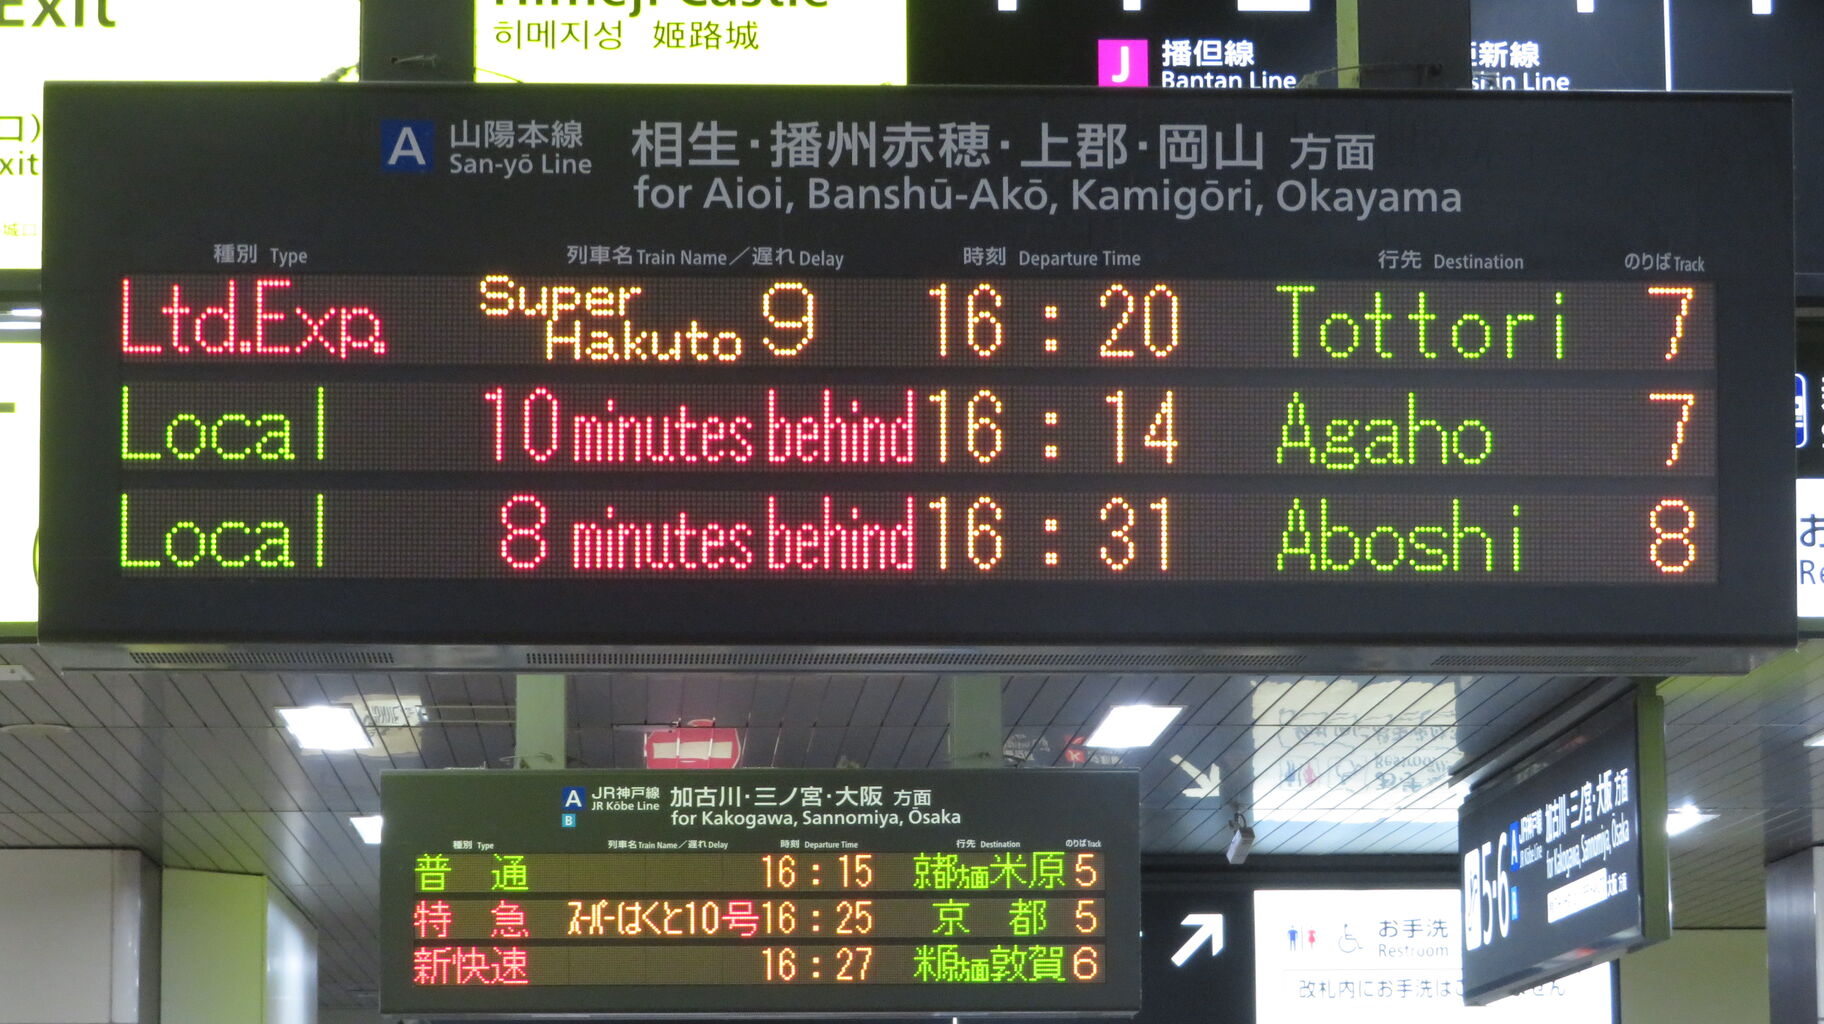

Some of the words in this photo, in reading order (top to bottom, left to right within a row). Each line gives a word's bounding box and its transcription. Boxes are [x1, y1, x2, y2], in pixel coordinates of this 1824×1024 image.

[493, 19, 623, 51] 히메지성
[1112, 45, 1130, 83] J
[1161, 39, 1256, 67] 播但線
[1470, 41, 1541, 69] 新線
[1161, 70, 1243, 88] Bantan
[1249, 70, 1298, 88] Line
[1522, 72, 1570, 91] Line
[387, 126, 427, 166] A
[449, 119, 584, 149] 山陽本線
[1290, 132, 1376, 172] 方面
[449, 152, 534, 180] San-yō
[541, 154, 593, 175] Line
[632, 174, 693, 210] for
[702, 177, 796, 214] Aioi,
[807, 177, 1059, 215] Banshū-Akō,
[1072, 178, 1264, 221] Kamigōri,
[1275, 178, 1463, 222] Okayama
[213, 243, 258, 265] 種別
[269, 246, 309, 267] Type
[566, 245, 633, 266] 列車名
[636, 249, 676, 266] Train
[799, 250, 844, 272] Delay
[963, 246, 1007, 267] 時刻
[1018, 250, 1098, 270] Departure
[1102, 250, 1142, 267] Time
[1377, 250, 1422, 270] 行先
[1433, 252, 1525, 270] Destination
[1623, 252, 1672, 272] のりば
[1674, 256, 1706, 274] Track
[480, 275, 642, 321] Super
[762, 282, 815, 357] 9
[1275, 284, 1565, 360] Tottori
[1648, 286, 1695, 361] 7
[546, 320, 743, 361] Hakuto
[121, 385, 326, 461] Local
[484, 387, 560, 463] 10
[572, 398, 754, 463] minutes
[767, 388, 916, 464] behind
[1276, 391, 1494, 471] Agaho
[1649, 392, 1696, 467] 7
[120, 492, 326, 569] Local
[500, 494, 548, 570] 8
[572, 505, 754, 570] minutes
[767, 495, 916, 571] behind
[1276, 497, 1521, 573] Aboshi
[1649, 498, 1696, 574] 8
[1799, 558, 1824, 586] R
[565, 789, 583, 808] A
[591, 801, 604, 812] JR
[606, 800, 635, 812] Kōbe
[637, 801, 661, 812] Line
[592, 786, 661, 801] JR神戸線
[893, 789, 932, 807] 方面
[564, 815, 574, 827] B
[671, 809, 698, 826] for
[702, 811, 799, 830] Kakogawa,
[802, 810, 905, 829] Sannomiya,
[908, 806, 962, 825] Ōsaka
[452, 839, 474, 850] 種別
[477, 841, 495, 850] Type
[607, 839, 638, 850] 列車名
[638, 841, 659, 850] Train
[708, 841, 729, 851] Delay
[780, 839, 800, 849] 時刻
[804, 841, 839, 850] Departure
[841, 841, 859, 849] Time
[956, 839, 976, 849] 行先
[980, 841, 1021, 849] Destination
[1065, 839, 1087, 848] のりば
[1075, 852, 1098, 888] 5
[1075, 899, 1098, 935] 5
[1378, 916, 1449, 940] お手洗
[1377, 943, 1449, 959] Restroom
[413, 945, 529, 985] 新快速
[1072, 945, 1099, 981] 6
